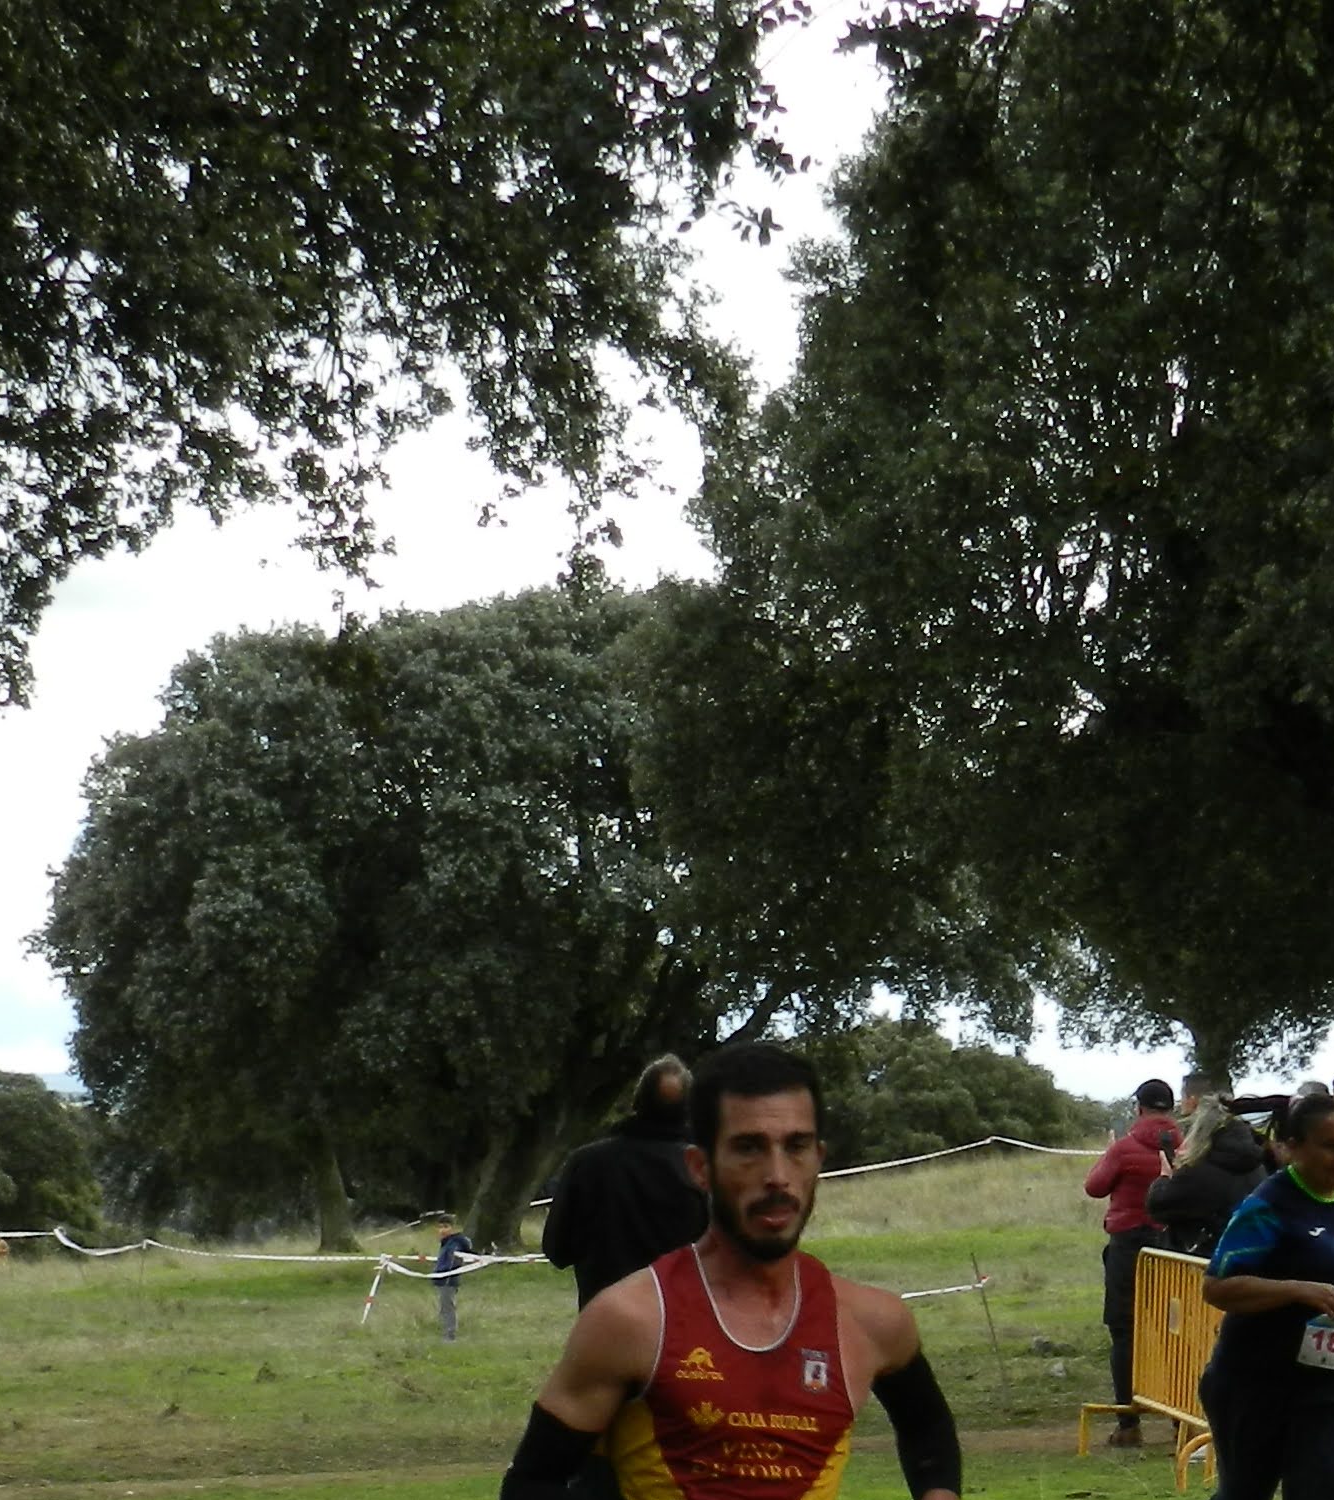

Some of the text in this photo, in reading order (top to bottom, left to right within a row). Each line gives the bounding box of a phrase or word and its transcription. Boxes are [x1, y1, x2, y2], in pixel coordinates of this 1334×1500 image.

[728, 1411, 820, 1432] CAJA RURAL
[733, 1463, 803, 1479] TORO
